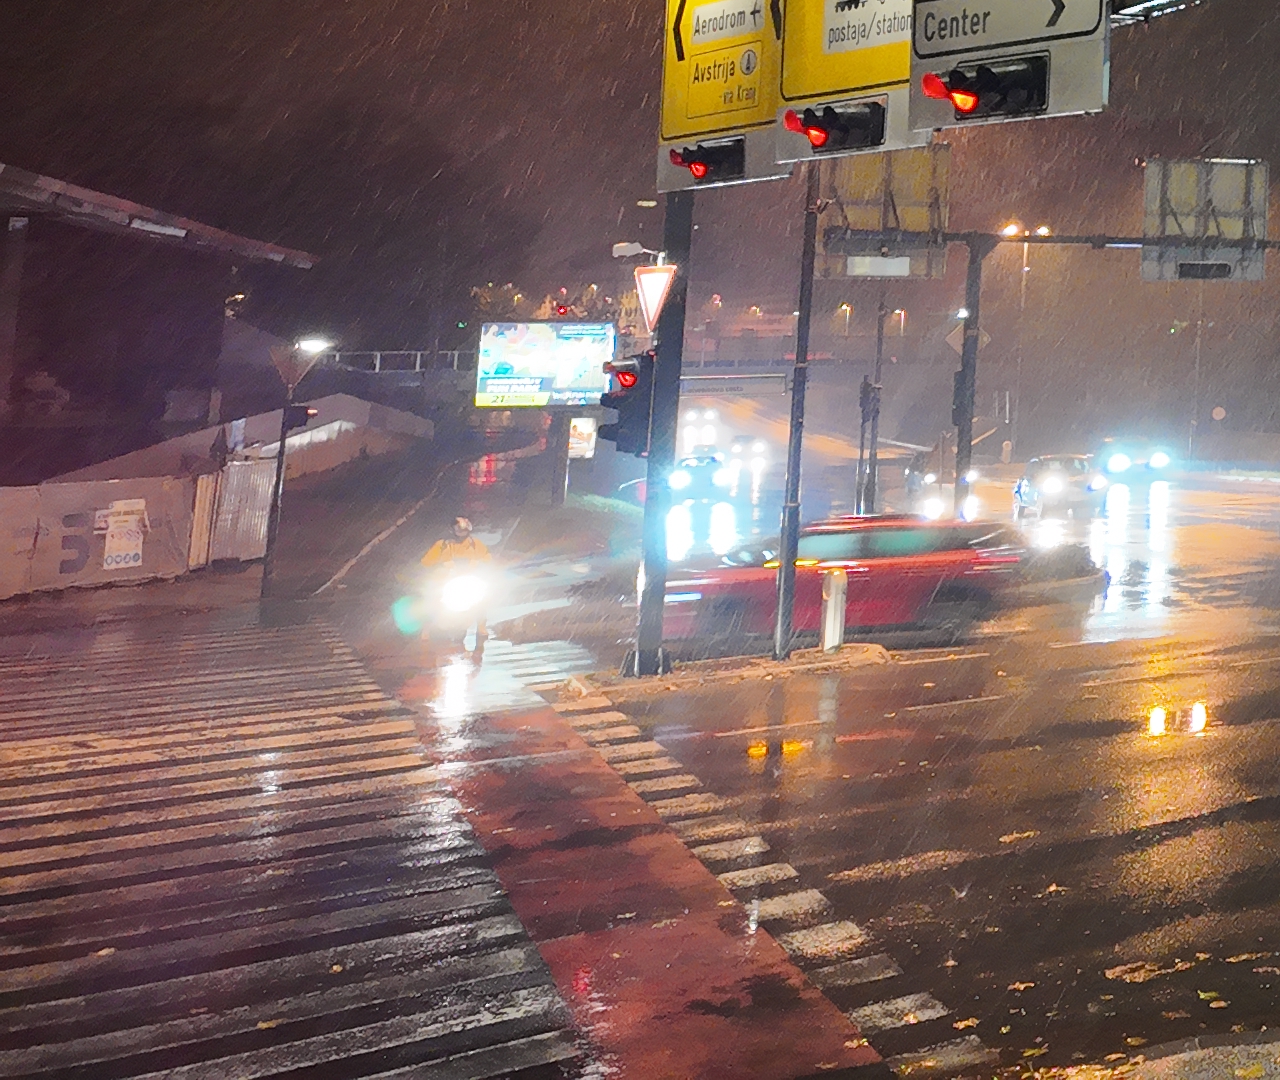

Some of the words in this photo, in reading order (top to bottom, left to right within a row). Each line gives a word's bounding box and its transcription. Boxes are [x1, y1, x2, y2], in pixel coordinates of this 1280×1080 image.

[693, 9, 746, 36] Aerodrom
[924, 7, 991, 42] Center
[692, 57, 736, 84] Avstrija
